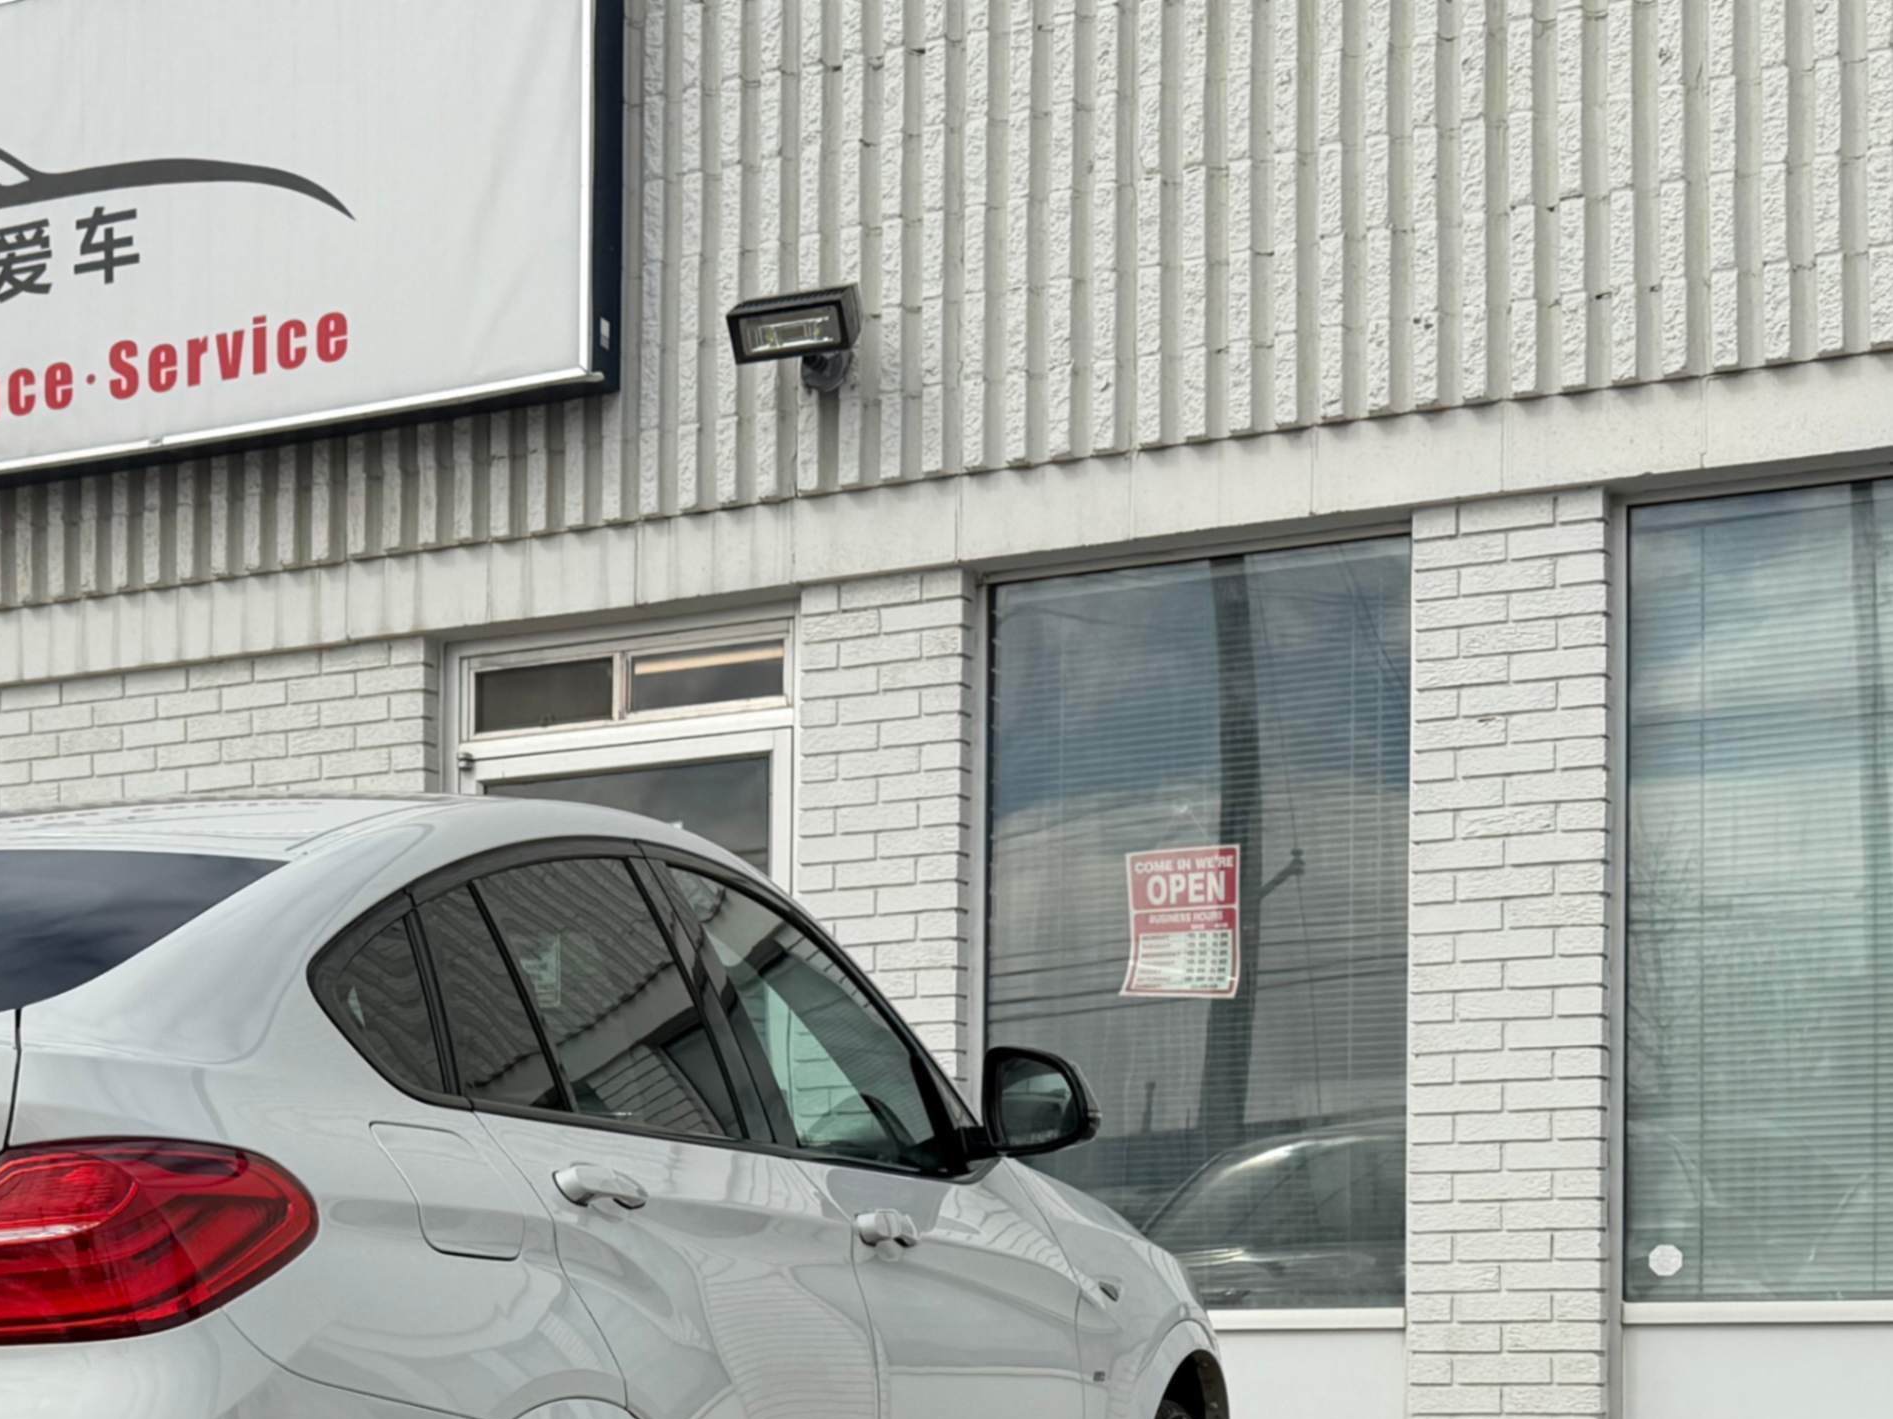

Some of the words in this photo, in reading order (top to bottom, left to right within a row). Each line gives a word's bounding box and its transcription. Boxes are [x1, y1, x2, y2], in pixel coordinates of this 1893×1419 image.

[108, 311, 349, 401] Service
[1135, 860, 1174, 874] COME
[1177, 859, 1192, 871] IN
[1195, 855, 1234, 869] WE'RE
[1147, 870, 1225, 905] OPEN
